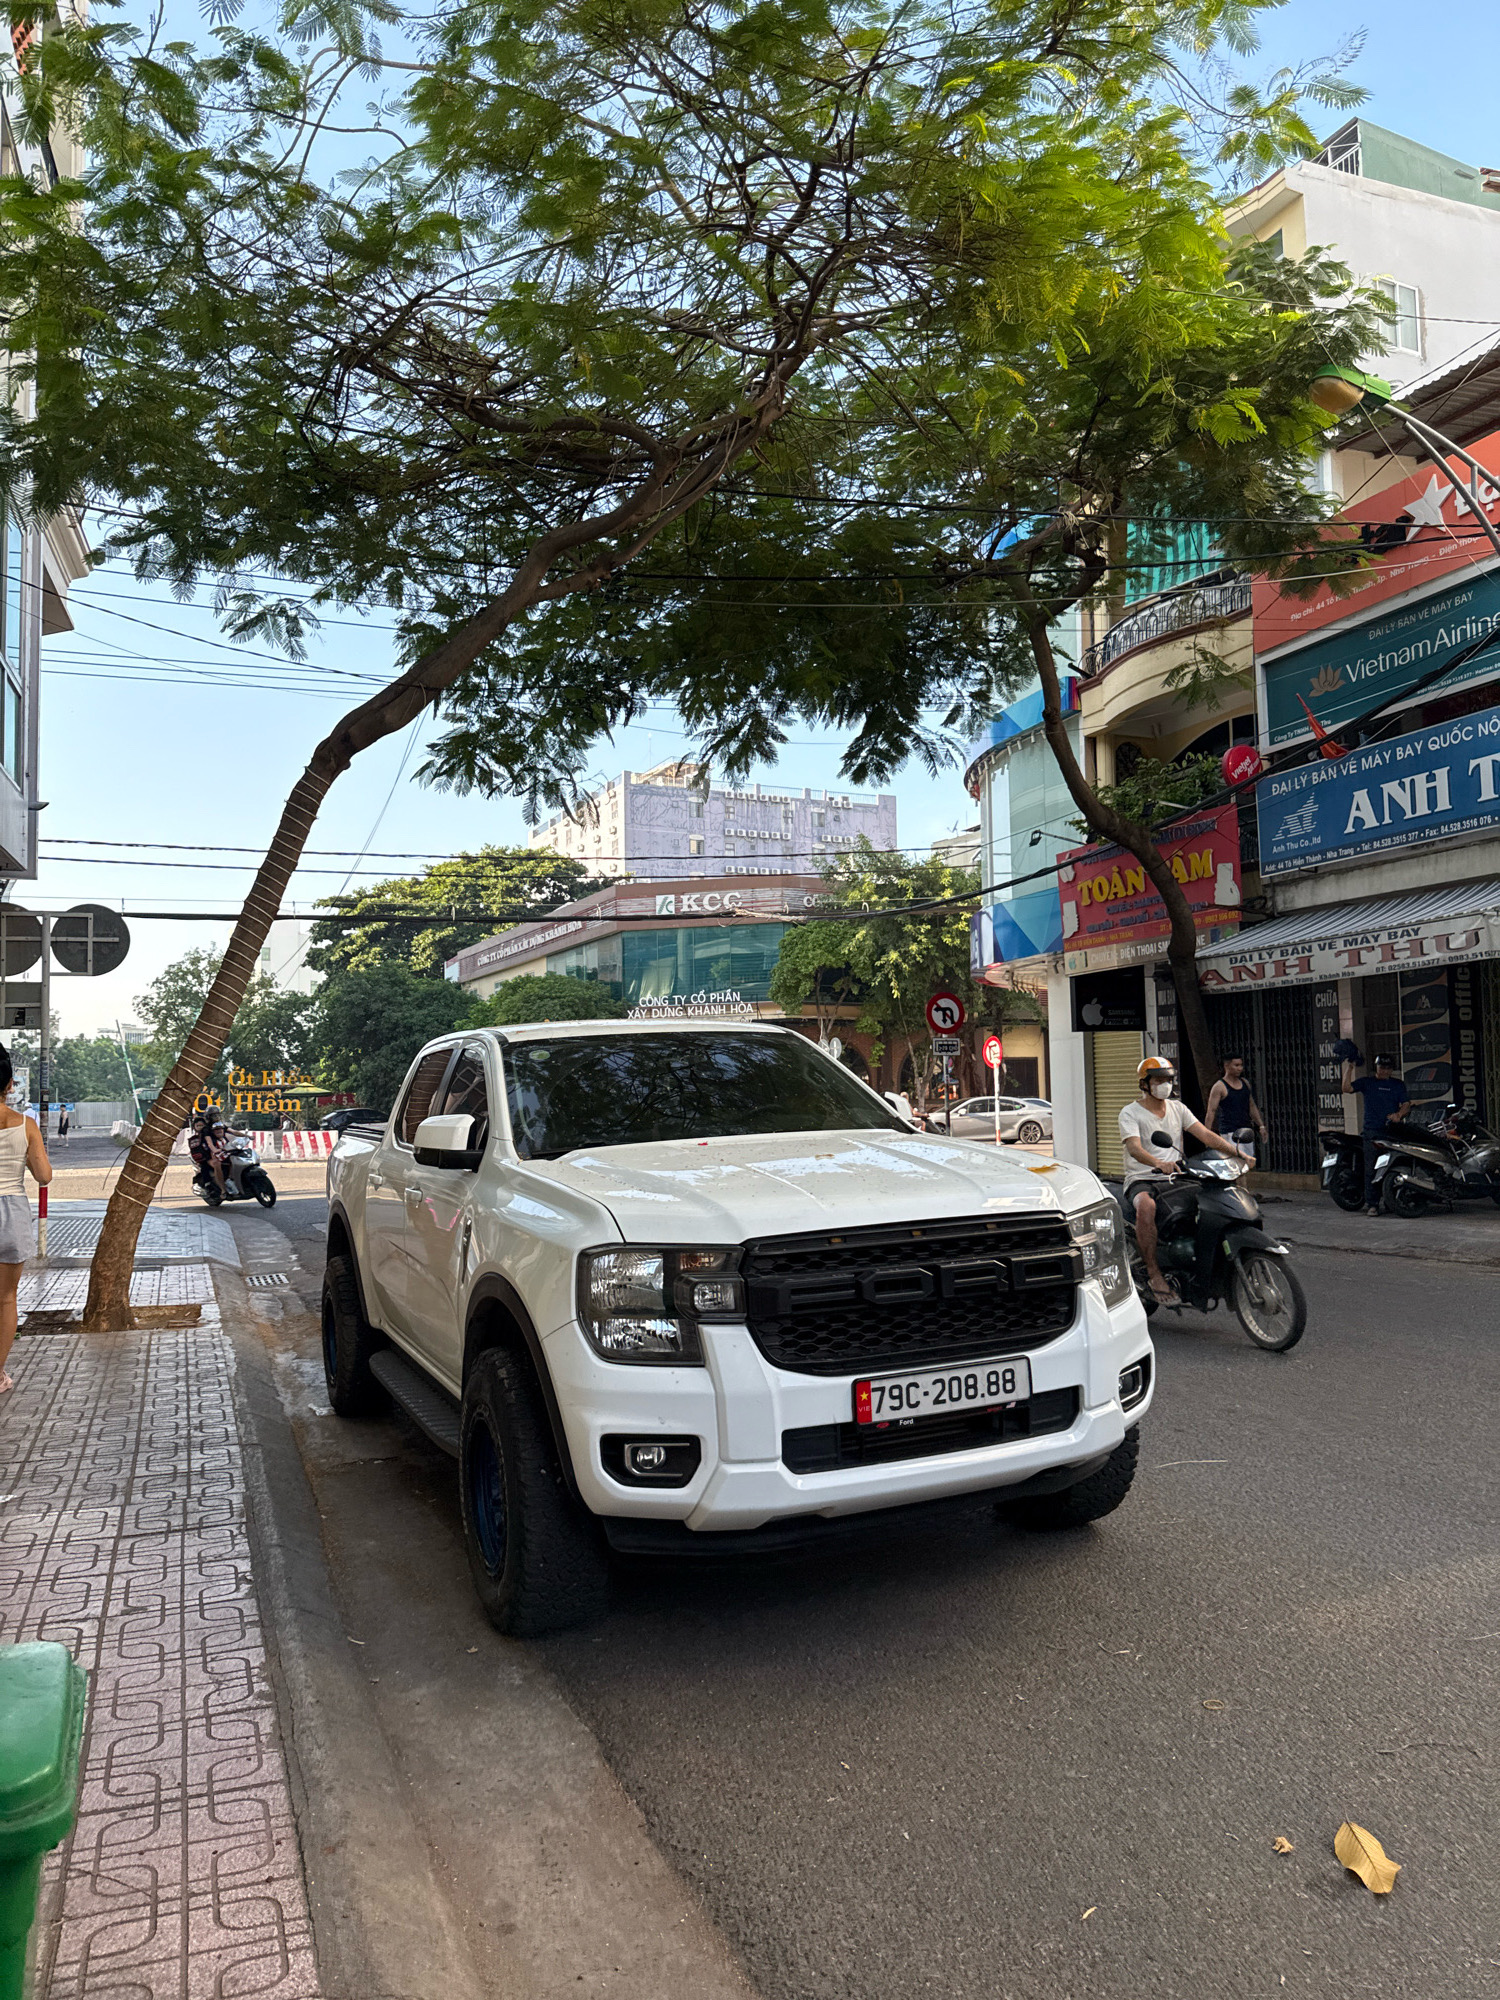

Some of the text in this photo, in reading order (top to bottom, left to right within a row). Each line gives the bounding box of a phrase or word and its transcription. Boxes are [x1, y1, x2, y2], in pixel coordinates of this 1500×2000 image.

[1316, 600, 1326, 610] 44
[1390, 567, 1405, 578] Nha
[1454, 590, 1475, 606] BAY
[1345, 639, 1431, 683] Vietnam
[1274, 732, 1287, 743] Công
[1271, 781, 1292, 797] ĐẠI
[1294, 772, 1308, 789] LÝ
[1311, 764, 1337, 785] BÁN
[1340, 757, 1358, 777] VÉ
[1361, 749, 1392, 772] MÁY
[1396, 740, 1424, 761] BAY
[1427, 723, 1474, 751] QUỐC
[1343, 766, 1453, 835] ANH
[1265, 862, 1277, 873] Add:
[1277, 861, 1285, 870] 44
[1285, 859, 1292, 869] Tô
[1305, 852, 1323, 865] Thành
[1326, 850, 1338, 860] Nha
[1339, 846, 1355, 859] Trang
[1361, 842, 1372, 852] Tel:
[1373, 835, 1407, 849] 84.528.3515
[1408, 831, 1419, 842] 377
[1425, 828, 1439, 838] Fax:
[1440, 818, 1479, 834] 84.528.3516
[1480, 815, 1492, 825] 076
[1272, 843, 1286, 855] Anh
[1287, 839, 1299, 852] Thu
[1166, 848, 1215, 884] ÂM
[680, 891, 743, 912] KCC
[1120, 945, 1136, 960] ĐIỆN
[1137, 943, 1157, 957] THOẠI
[1229, 926, 1422, 965] ĐẠI LÝ BÁN VÉ MÁY BAY
[1199, 927, 1485, 988] ANH THU
[1319, 972, 1340, 981] Khánh
[639, 988, 741, 1007] CÔNG TY CỔ PHẦN
[1315, 989, 1338, 1008] CHỮA
[627, 1007, 648, 1020] XÂY
[688, 1003, 726, 1017] KHÁNH
[730, 1001, 754, 1014] HÒA
[1322, 1015, 1334, 1033] ÉP
[1319, 1039, 1338, 1058] KÍN
[228, 1066, 254, 1088] Ớt
[1320, 1064, 1341, 1081] ĐIỆN
[750, 1248, 1083, 1316] FORD
[871, 1368, 1016, 1414] 79C-208.88
[899, 1418, 914, 1426] Ford
